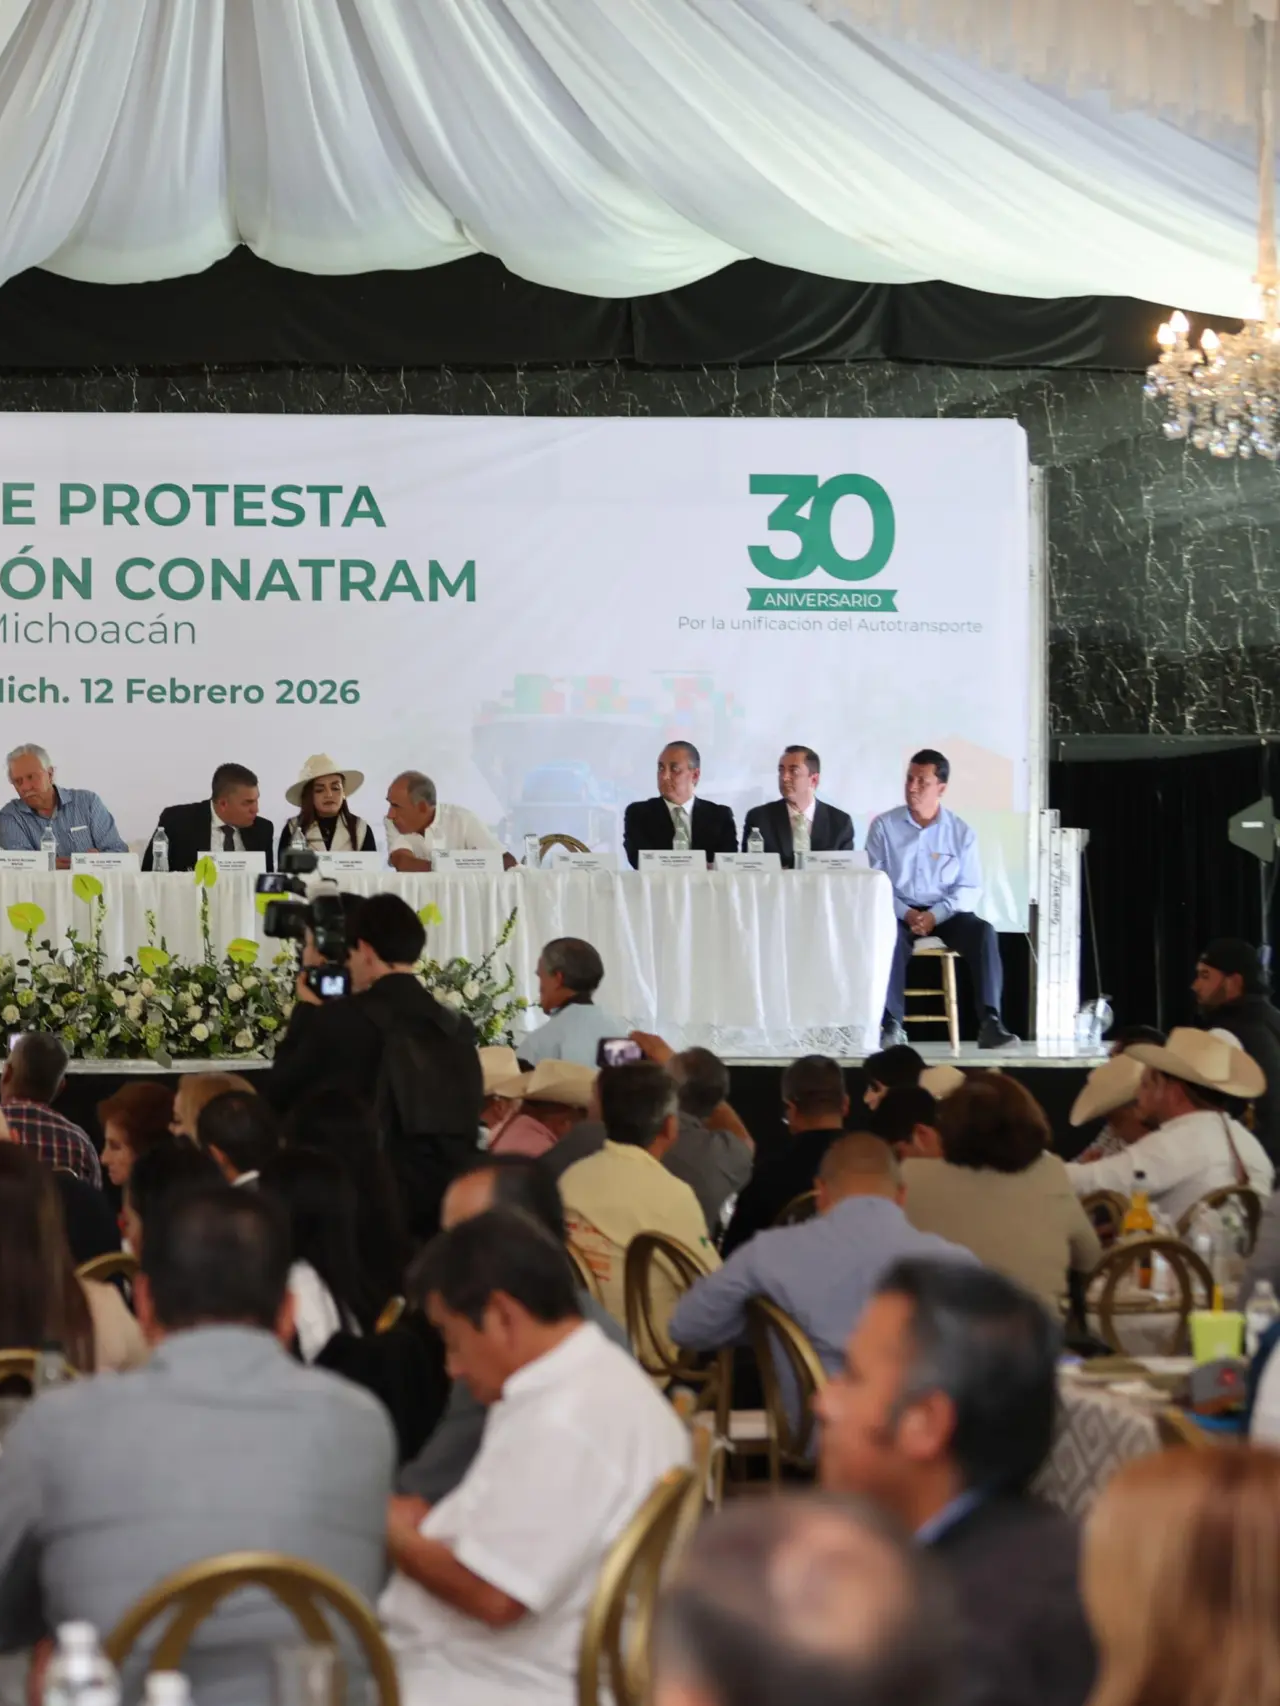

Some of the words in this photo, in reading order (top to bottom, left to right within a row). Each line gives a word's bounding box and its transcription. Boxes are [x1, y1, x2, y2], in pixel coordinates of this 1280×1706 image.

[59, 481, 387, 529] PROTESTA
[745, 472, 897, 582] 30
[115, 555, 477, 604] CONATRAM
[763, 593, 882, 608] ANIVERSARIO
[677, 616, 707, 630] Por
[711, 615, 726, 630] la
[730, 616, 823, 631] unificación
[827, 616, 853, 632] del
[857, 618, 984, 635] Autotransporte
[81, 678, 114, 704] 12
[126, 678, 265, 705] Febrero
[277, 679, 362, 706] 2026
